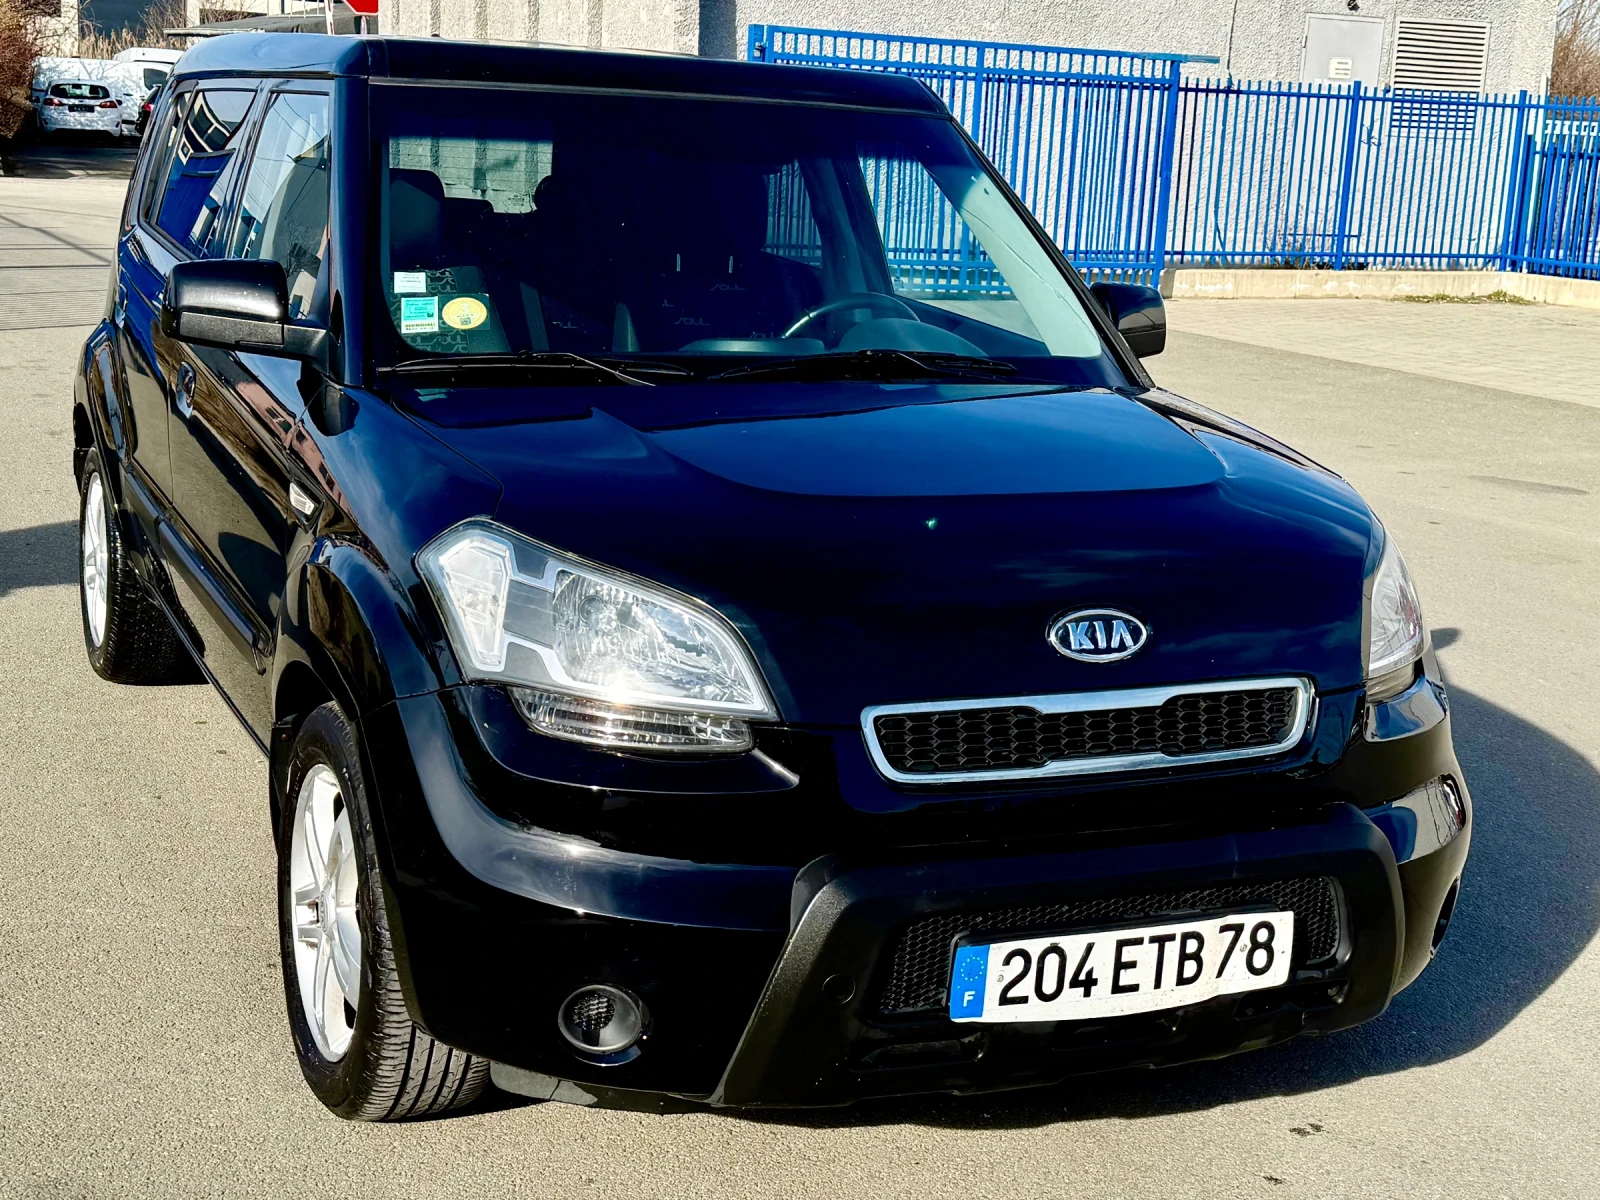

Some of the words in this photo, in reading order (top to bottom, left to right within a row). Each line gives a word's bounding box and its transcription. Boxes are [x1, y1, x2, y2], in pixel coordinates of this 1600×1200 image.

[1066, 619, 1135, 650] KIA
[998, 942, 1099, 1007] 204
[1111, 930, 1205, 995] ETB
[1215, 920, 1276, 979] 78
[963, 990, 976, 1008] F
